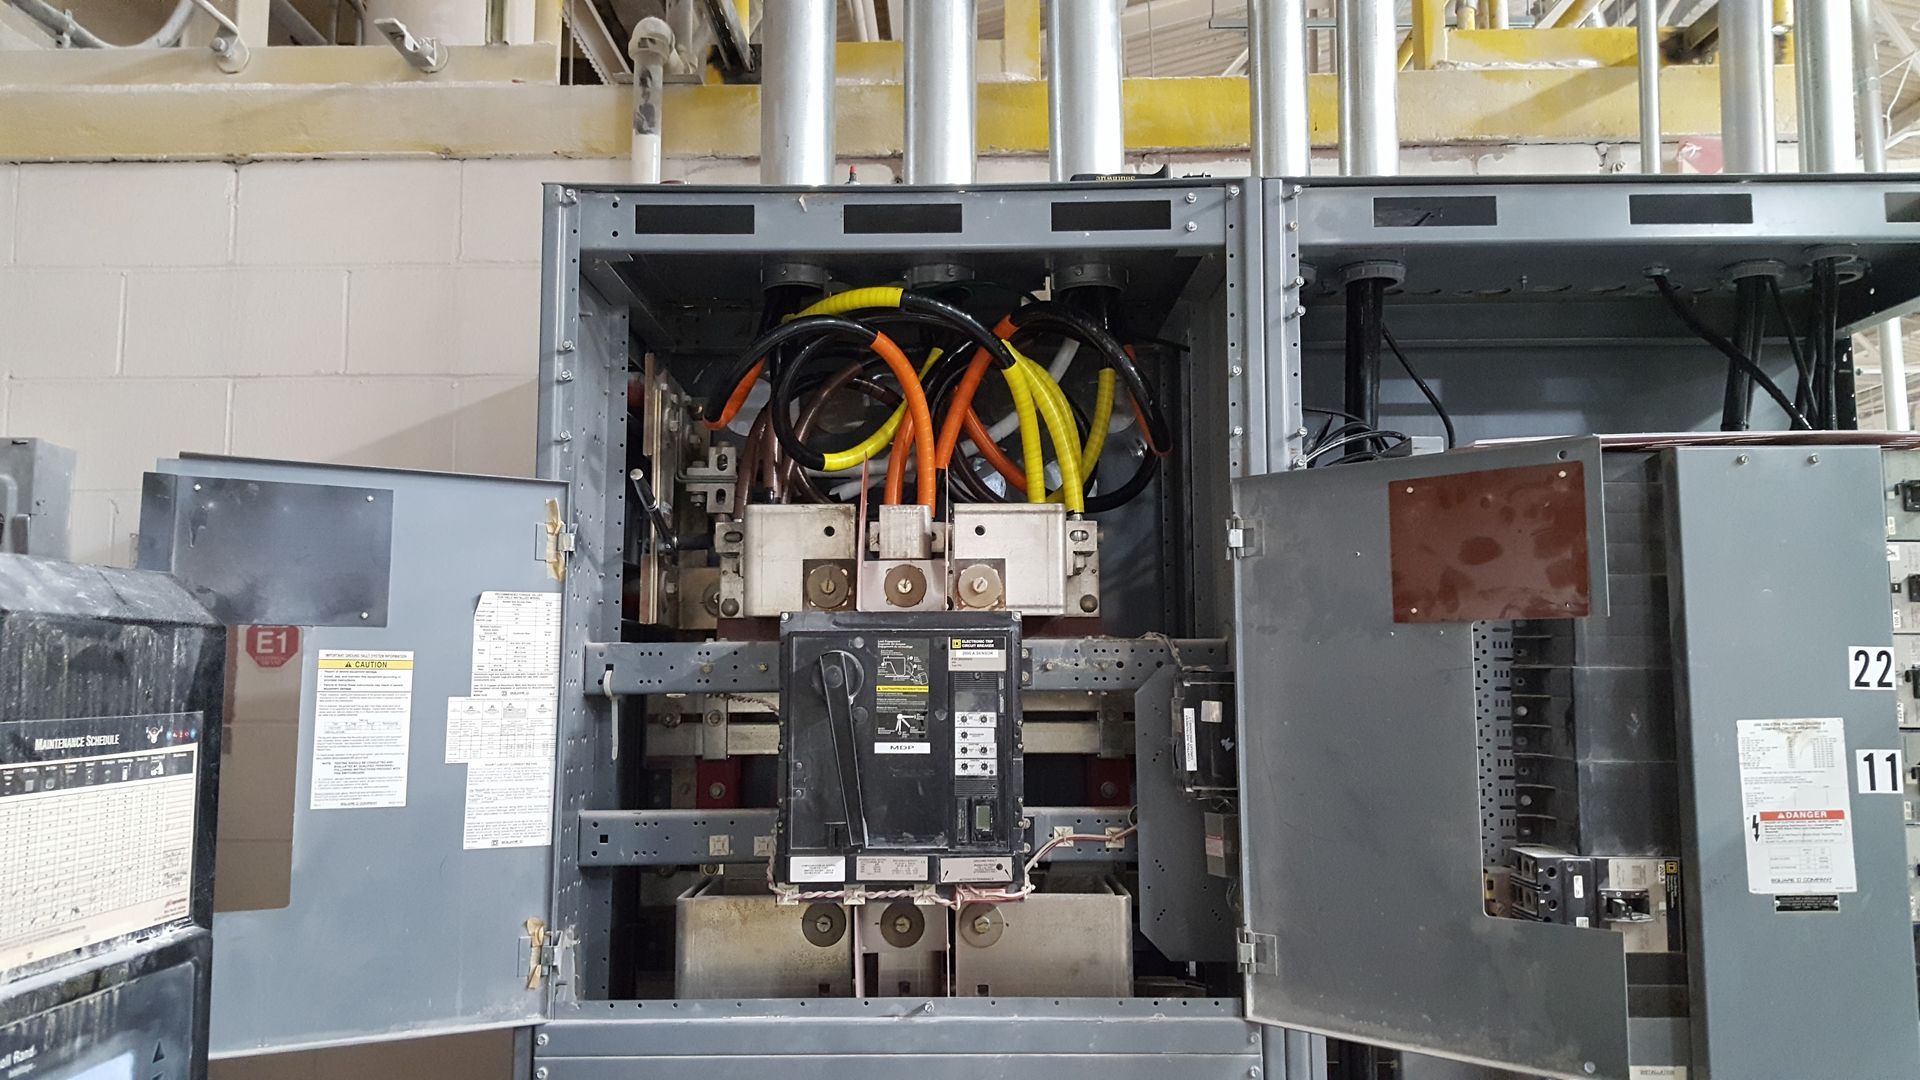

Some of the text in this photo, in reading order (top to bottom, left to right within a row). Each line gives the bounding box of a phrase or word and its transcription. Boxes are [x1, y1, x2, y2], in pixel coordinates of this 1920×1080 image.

[257, 631, 287, 653] E1
[1854, 649, 1893, 688] 22
[34, 734, 120, 751] MAINTENANCE SCHEDULE
[1863, 752, 1899, 792] 11
[1786, 810, 1827, 819] DANGER
